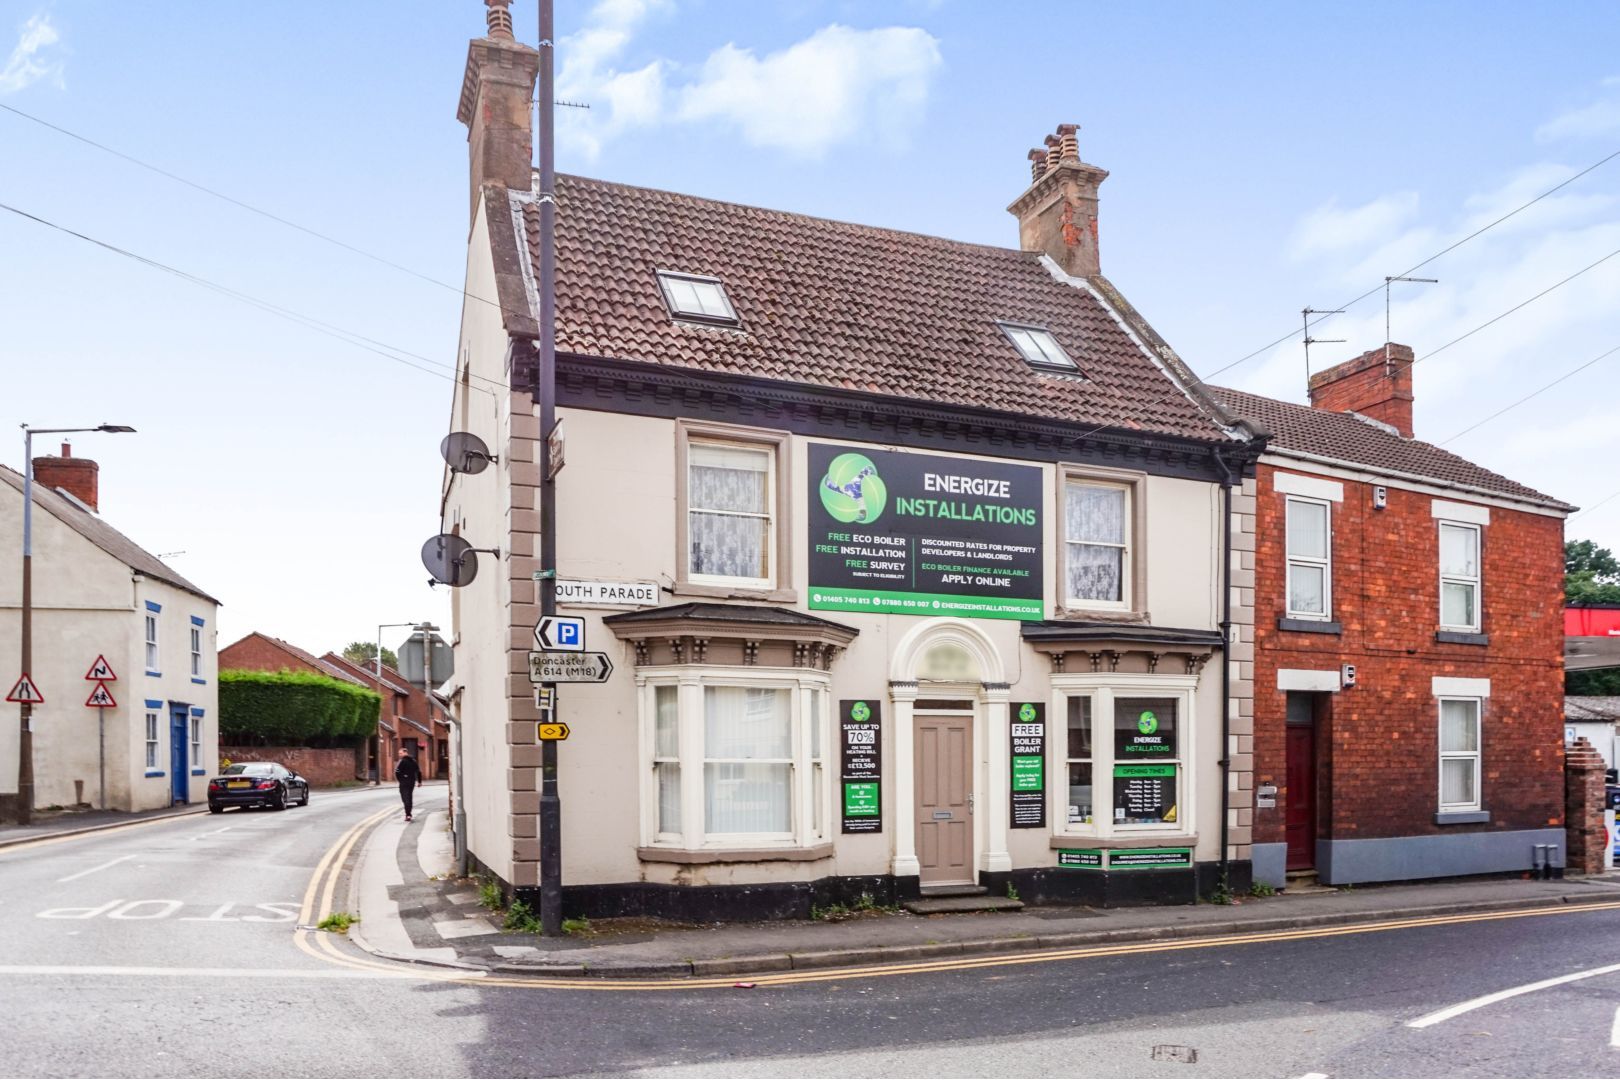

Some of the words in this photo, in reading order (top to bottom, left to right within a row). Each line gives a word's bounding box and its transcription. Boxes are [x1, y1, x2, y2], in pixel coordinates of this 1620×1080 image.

[924, 473, 1010, 498] ENERGIZE
[896, 497, 1036, 526] INSTALLATIONS
[828, 532, 850, 542] FREE
[852, 534, 872, 543] ECO
[874, 536, 906, 546] BOILER
[922, 538, 965, 548] DISCOUNTED
[966, 542, 988, 550] RATES
[1003, 545, 1036, 554] PROPERTY
[816, 544, 838, 554] FREE
[840, 546, 906, 558] INSTALLATION
[922, 548, 965, 558] DEVELOPERS
[974, 552, 1013, 560] LANDLORDS
[846, 560, 868, 568] FREE
[870, 561, 906, 571] SURVEY
[938, 564, 962, 572] BOILER
[963, 566, 991, 574] FINANCE
[993, 568, 1030, 576] AVAILABLE
[941, 574, 974, 584] APPLY
[976, 576, 1011, 587] ONLINE
[555, 585, 592, 597] OUTH
[600, 587, 653, 600] PARADE
[562, 625, 574, 642] P
[534, 657, 586, 665] Doncaster
[850, 732, 874, 742] 70%
[1014, 726, 1040, 734] FREE
[35, 900, 302, 922] STOP
